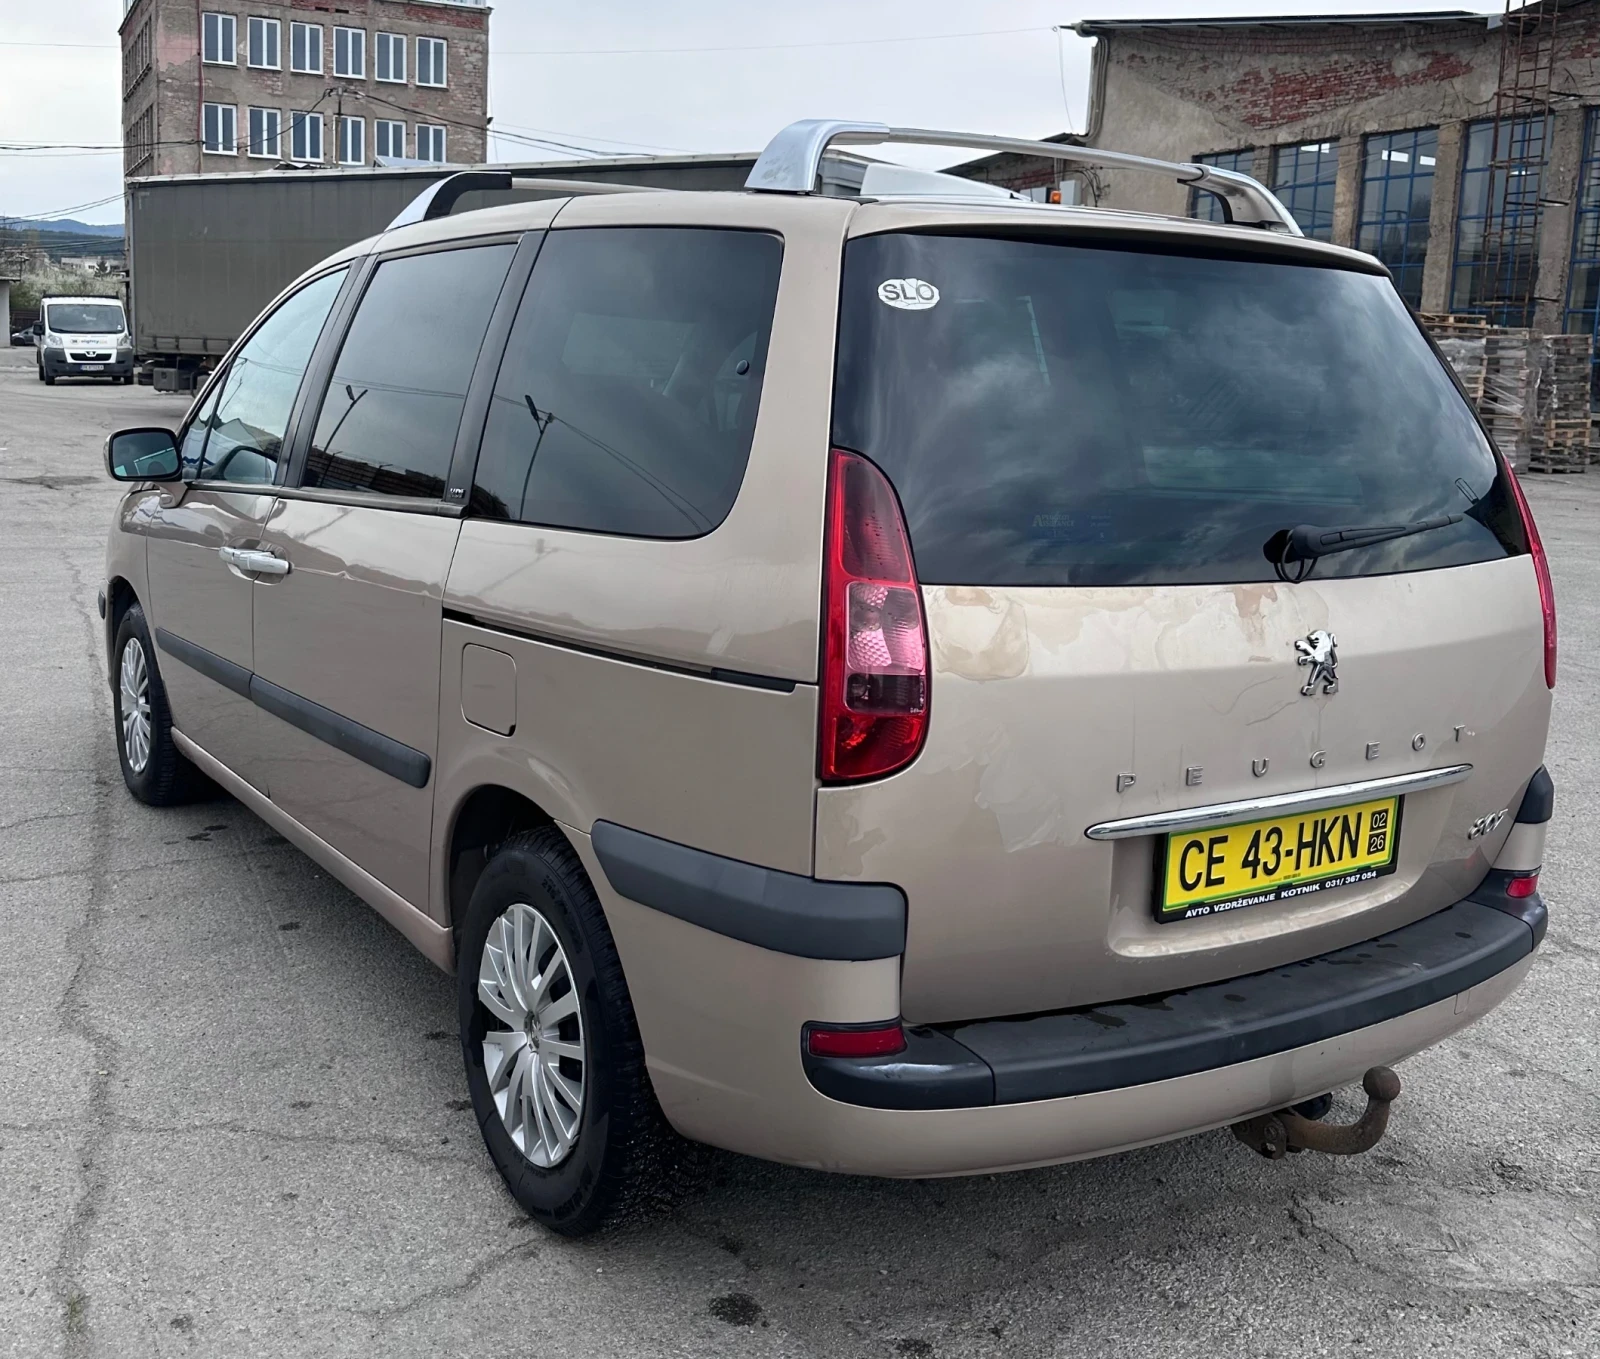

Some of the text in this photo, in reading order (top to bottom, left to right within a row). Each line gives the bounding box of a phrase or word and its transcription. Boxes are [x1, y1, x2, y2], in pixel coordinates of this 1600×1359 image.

[882, 283, 935, 301] SLO
[1116, 725, 1466, 793] PEUGEOT
[1372, 811, 1387, 828] 02
[1179, 811, 1363, 892] CE 43-HKN
[1370, 835, 1384, 852] 26
[1185, 870, 1377, 918] AVTO VZDRŽEVANJE KOTNIK 031/ 367 054
